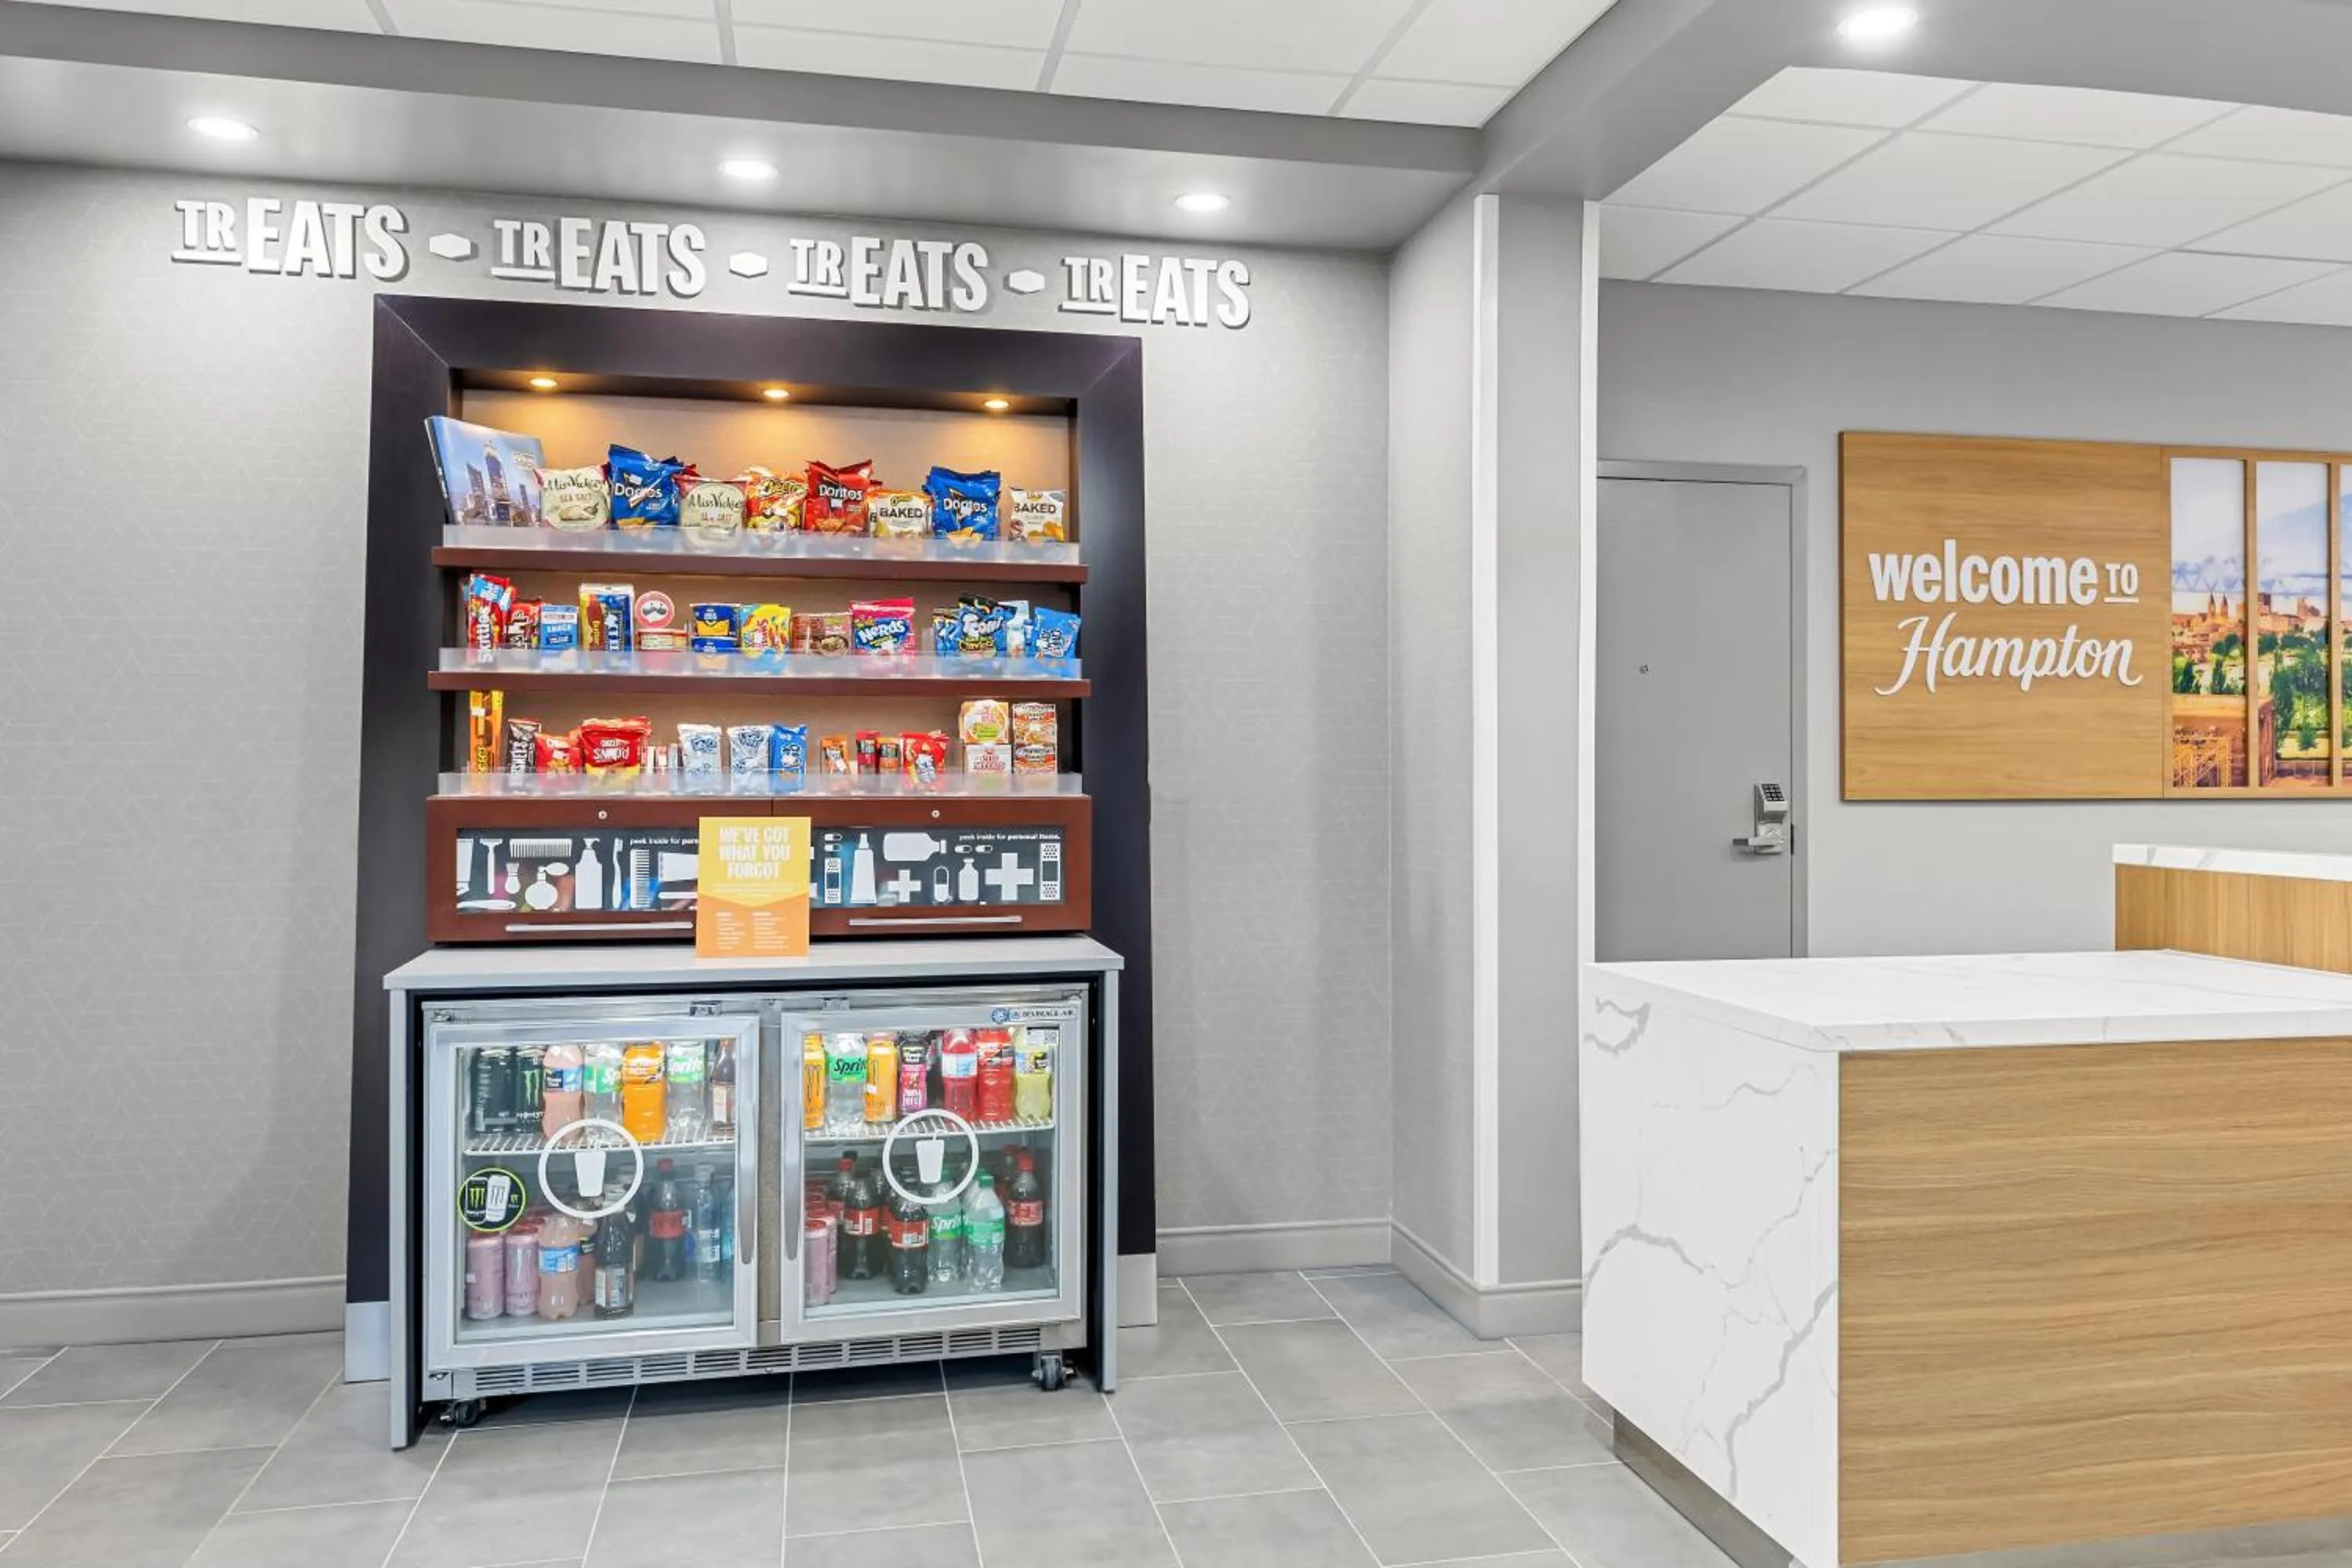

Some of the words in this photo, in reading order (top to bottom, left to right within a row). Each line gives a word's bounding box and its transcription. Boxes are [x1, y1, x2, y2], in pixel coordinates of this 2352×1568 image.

[173, 197, 408, 281] TREATS
[491, 217, 706, 299] TREATS
[787, 236, 989, 311] TREATS
[1060, 253, 1251, 328] TREATS
[818, 484, 862, 501] Doritos
[879, 507, 924, 519] BAKED
[1014, 502, 1057, 514] BAKED
[1868, 539, 2099, 606] welcome
[2103, 562, 2140, 603] TO
[1873, 611, 2143, 695] Hampton
[670, 836, 681, 844] for
[719, 826, 759, 844] WE'VE
[764, 826, 789, 844] GOT
[719, 844, 758, 862] WHAT
[762, 844, 790, 862] YOU
[727, 862, 779, 879] FORGOT
